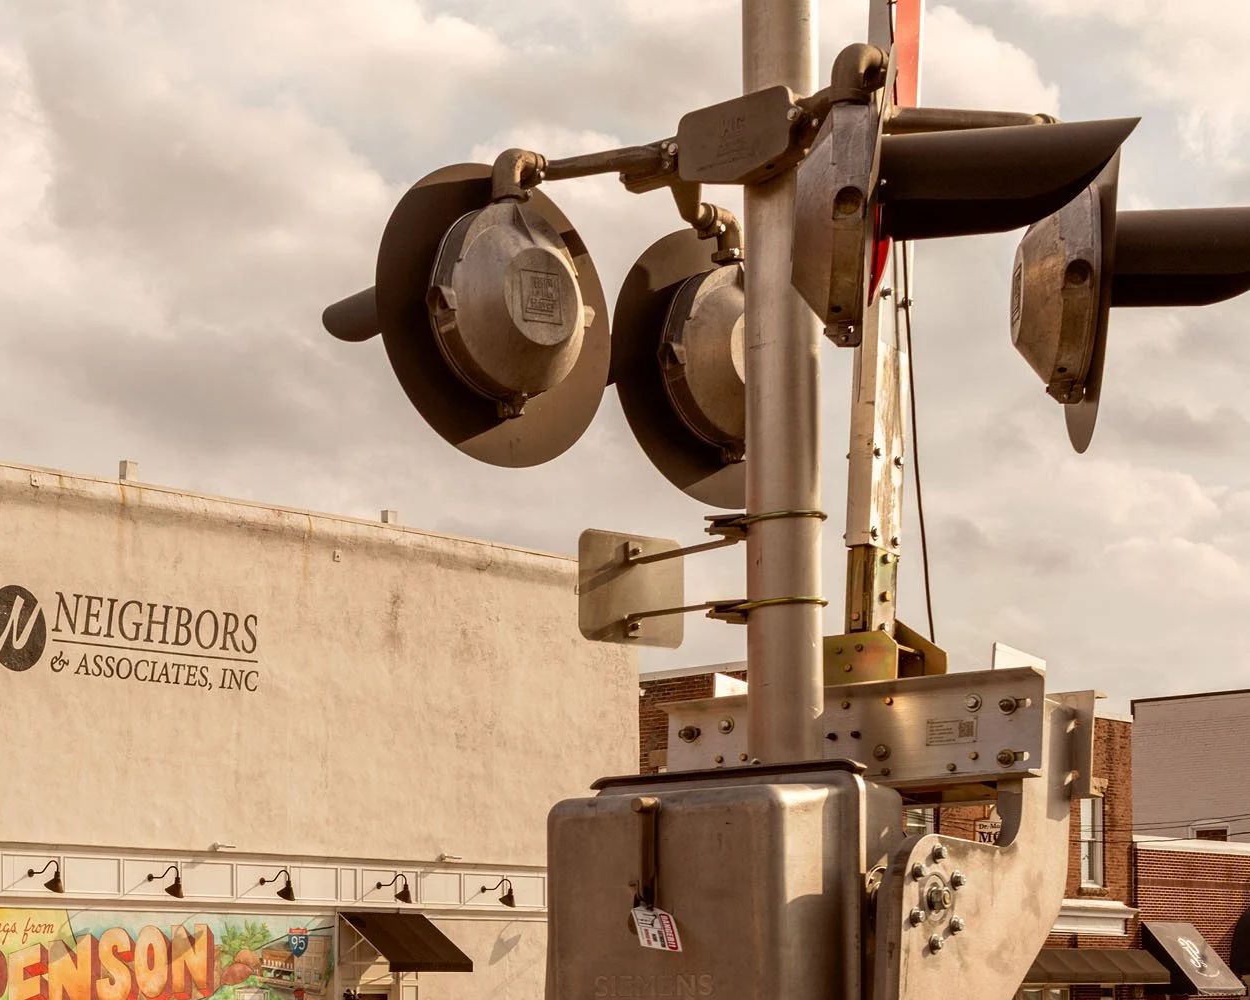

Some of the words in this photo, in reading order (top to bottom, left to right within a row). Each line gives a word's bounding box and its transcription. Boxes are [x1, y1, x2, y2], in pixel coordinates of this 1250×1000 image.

[51, 591, 258, 654] NEIGHBORS
[50, 651, 70, 672] &
[74, 653, 213, 691] ASSOCIATES,
[218, 668, 259, 692] INC
[22, 917, 55, 945] from
[291, 935, 306, 950] 95
[593, 974, 715, 998] SIEMENS
